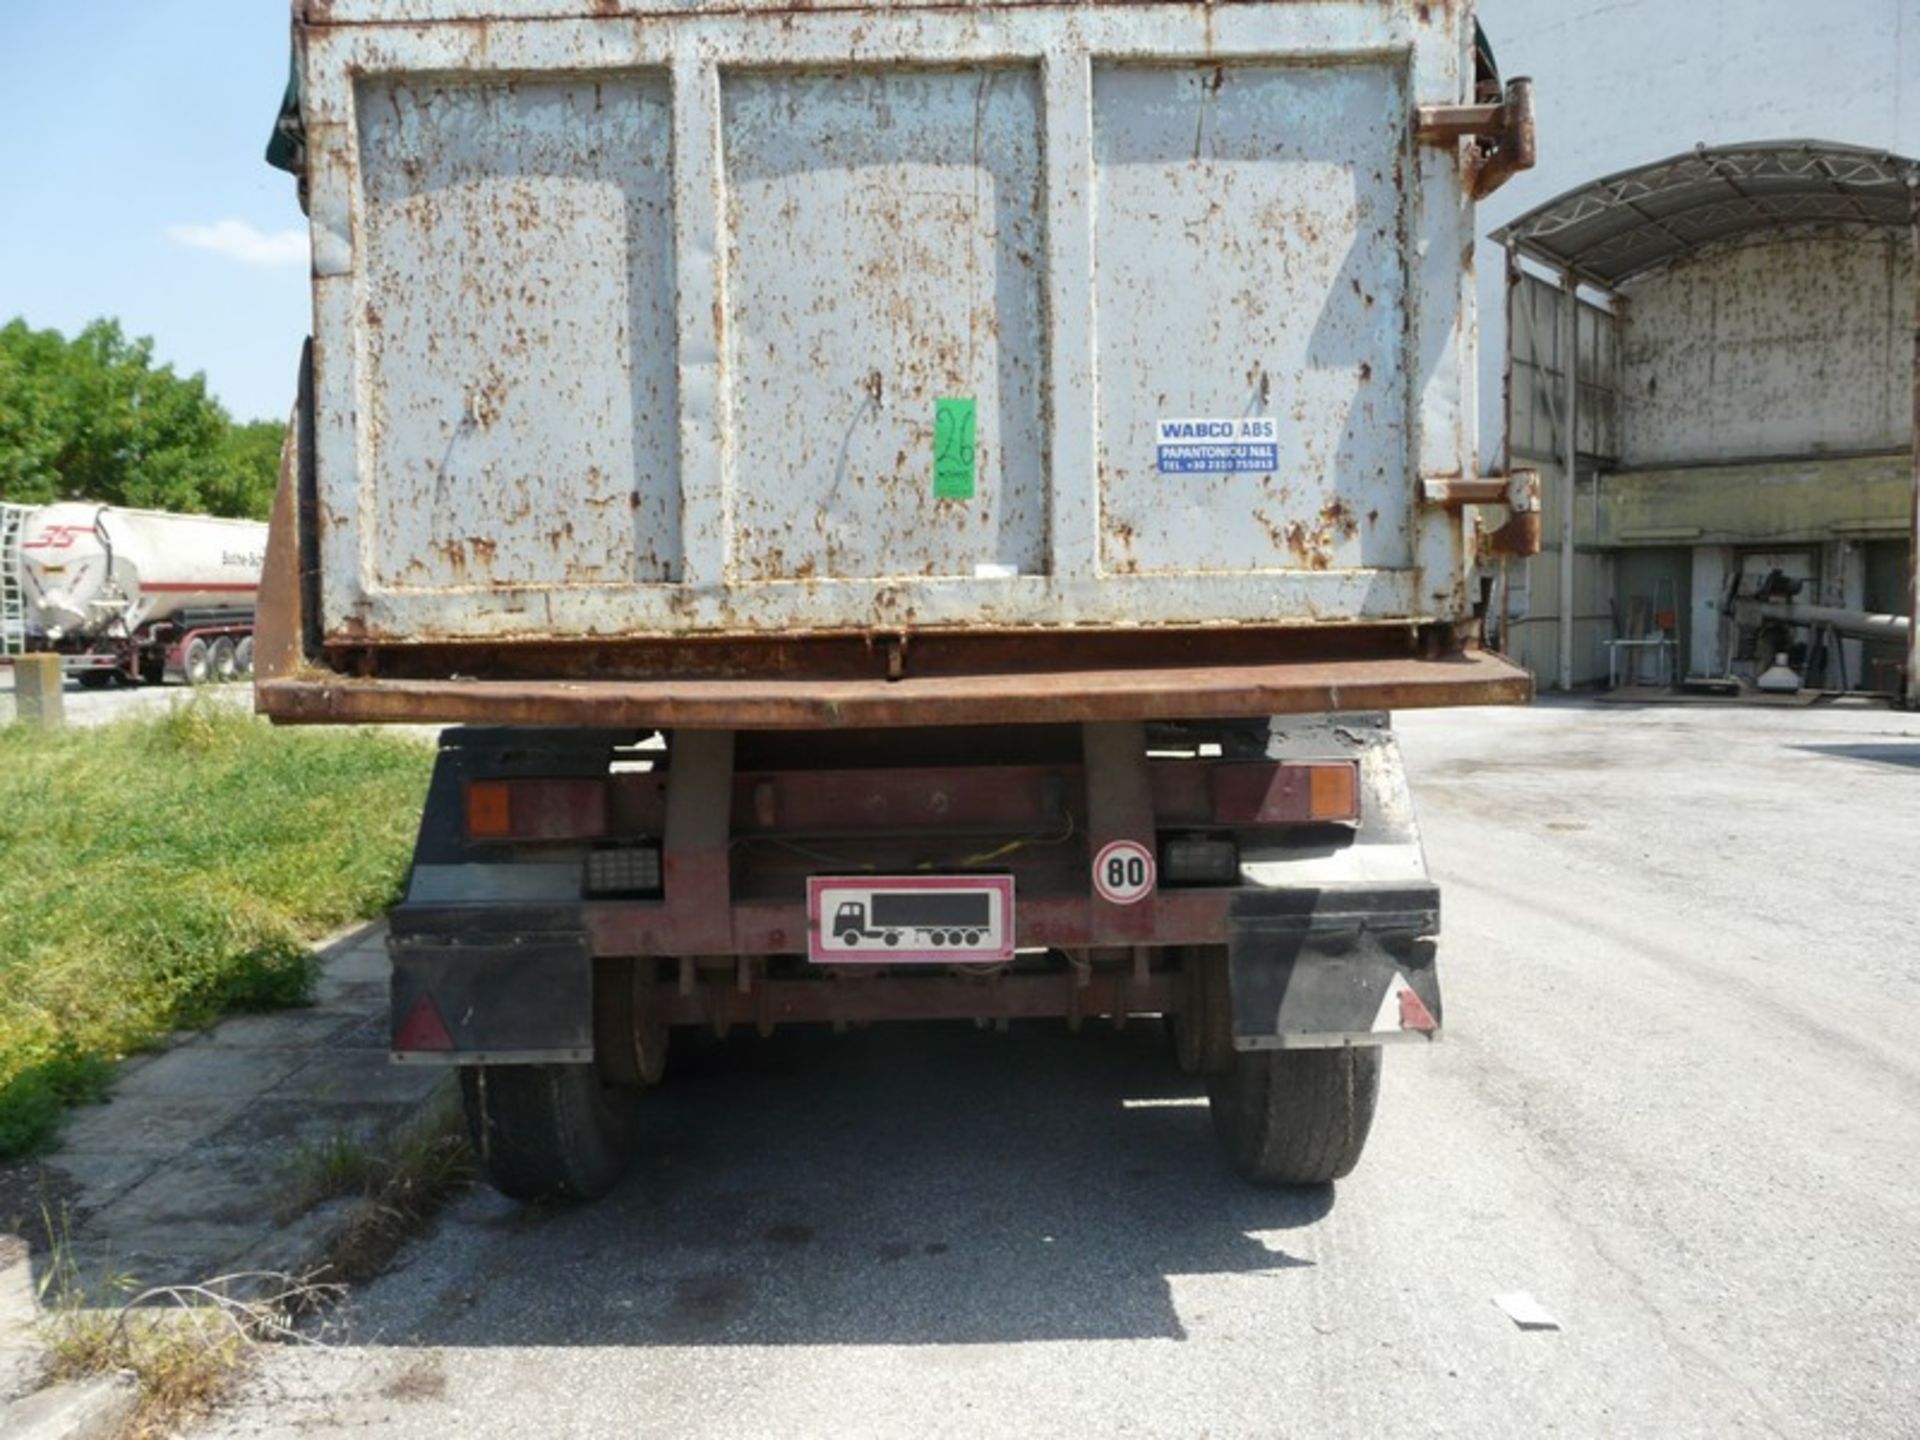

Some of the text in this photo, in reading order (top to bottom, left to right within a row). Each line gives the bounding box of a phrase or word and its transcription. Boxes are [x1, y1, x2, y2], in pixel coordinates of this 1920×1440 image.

[1162, 422, 1273, 438] WABCO ABS
[1162, 446, 1247, 459] PAPANTONIOU
[1108, 857, 1144, 888] 80
